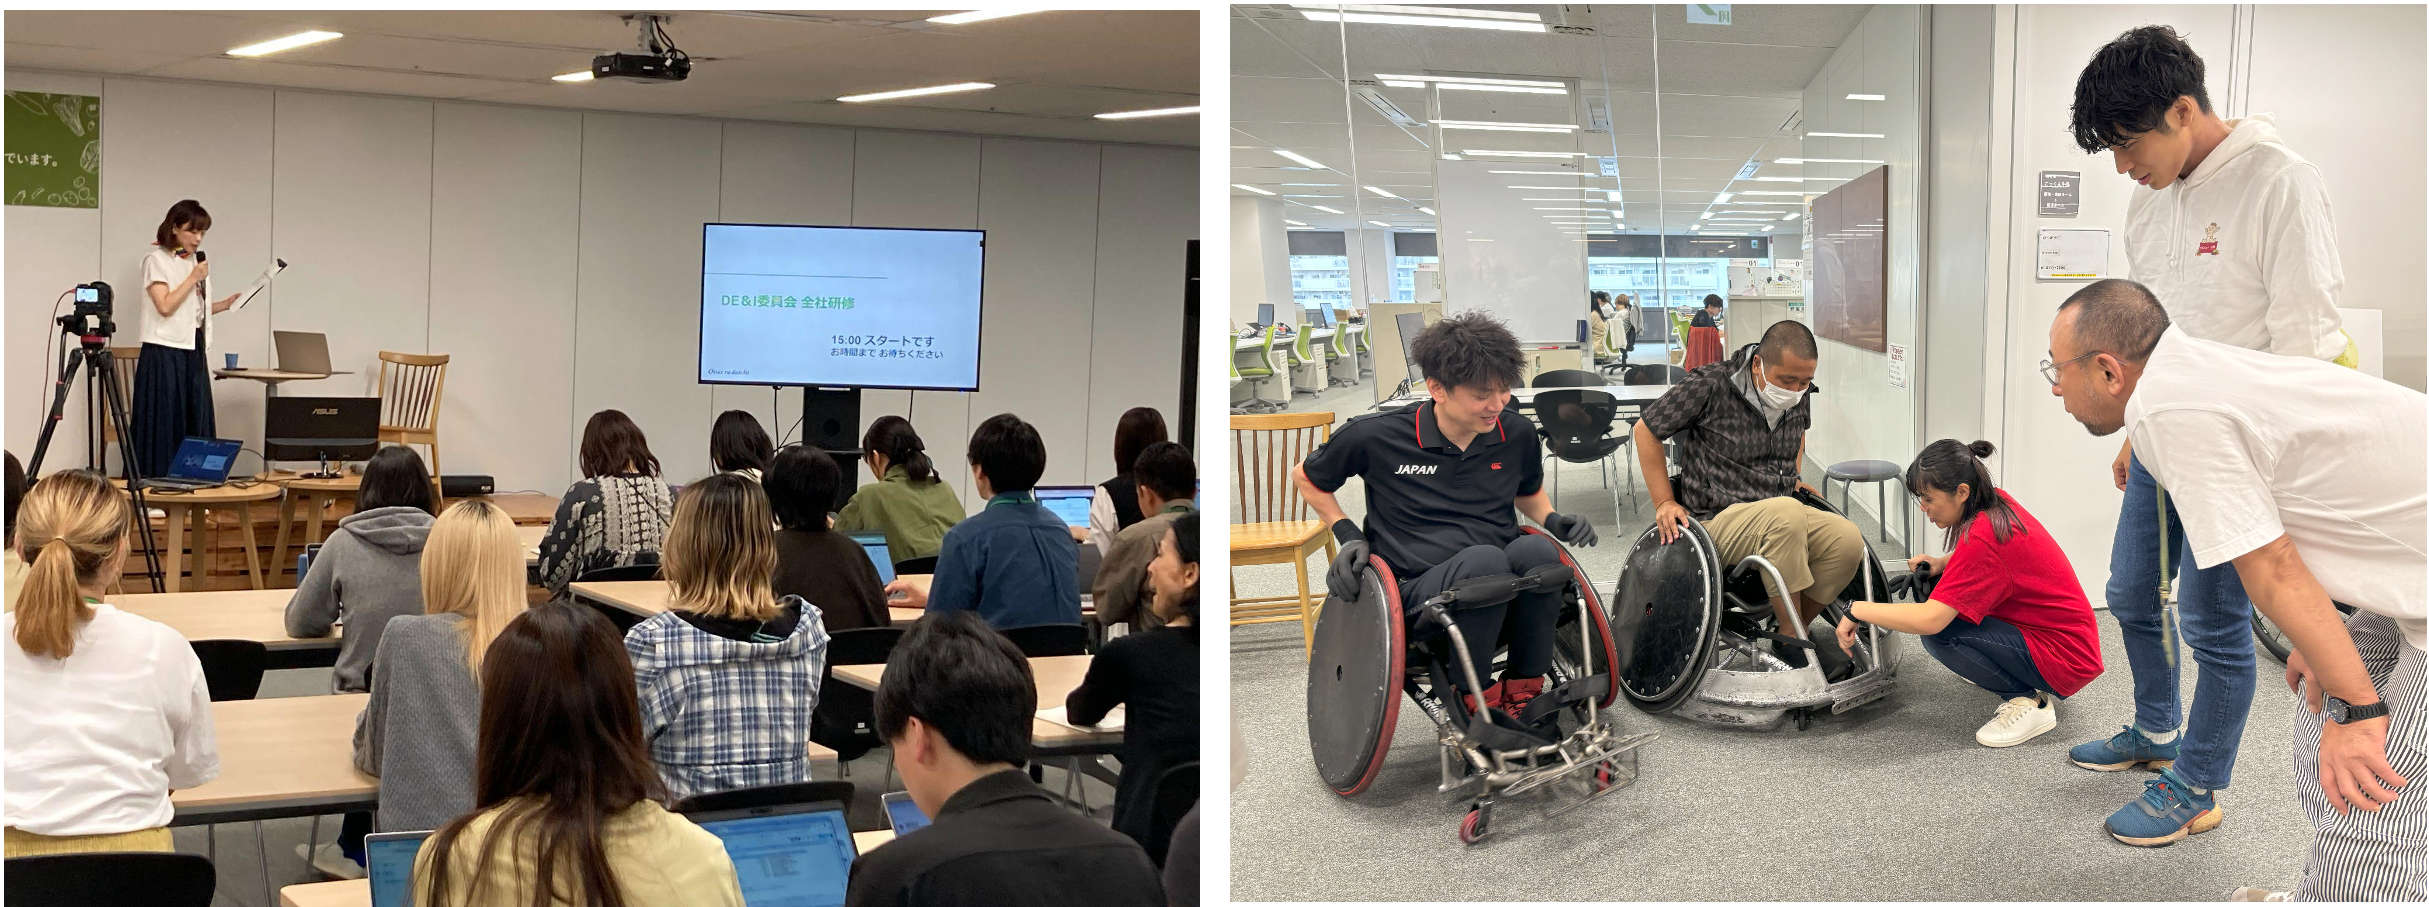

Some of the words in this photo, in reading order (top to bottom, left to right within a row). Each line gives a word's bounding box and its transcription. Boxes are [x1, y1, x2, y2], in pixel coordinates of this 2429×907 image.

[4, 153, 58, 167] でいます。
[721, 295, 798, 308] DE&I委員会
[801, 295, 855, 310] 全社研修
[831, 335, 861, 345] 15:00
[864, 335, 935, 347] スタートです
[830, 347, 876, 357] お時間まで
[879, 349, 944, 359] お待ちください
[1395, 464, 1438, 475] JAPAN
